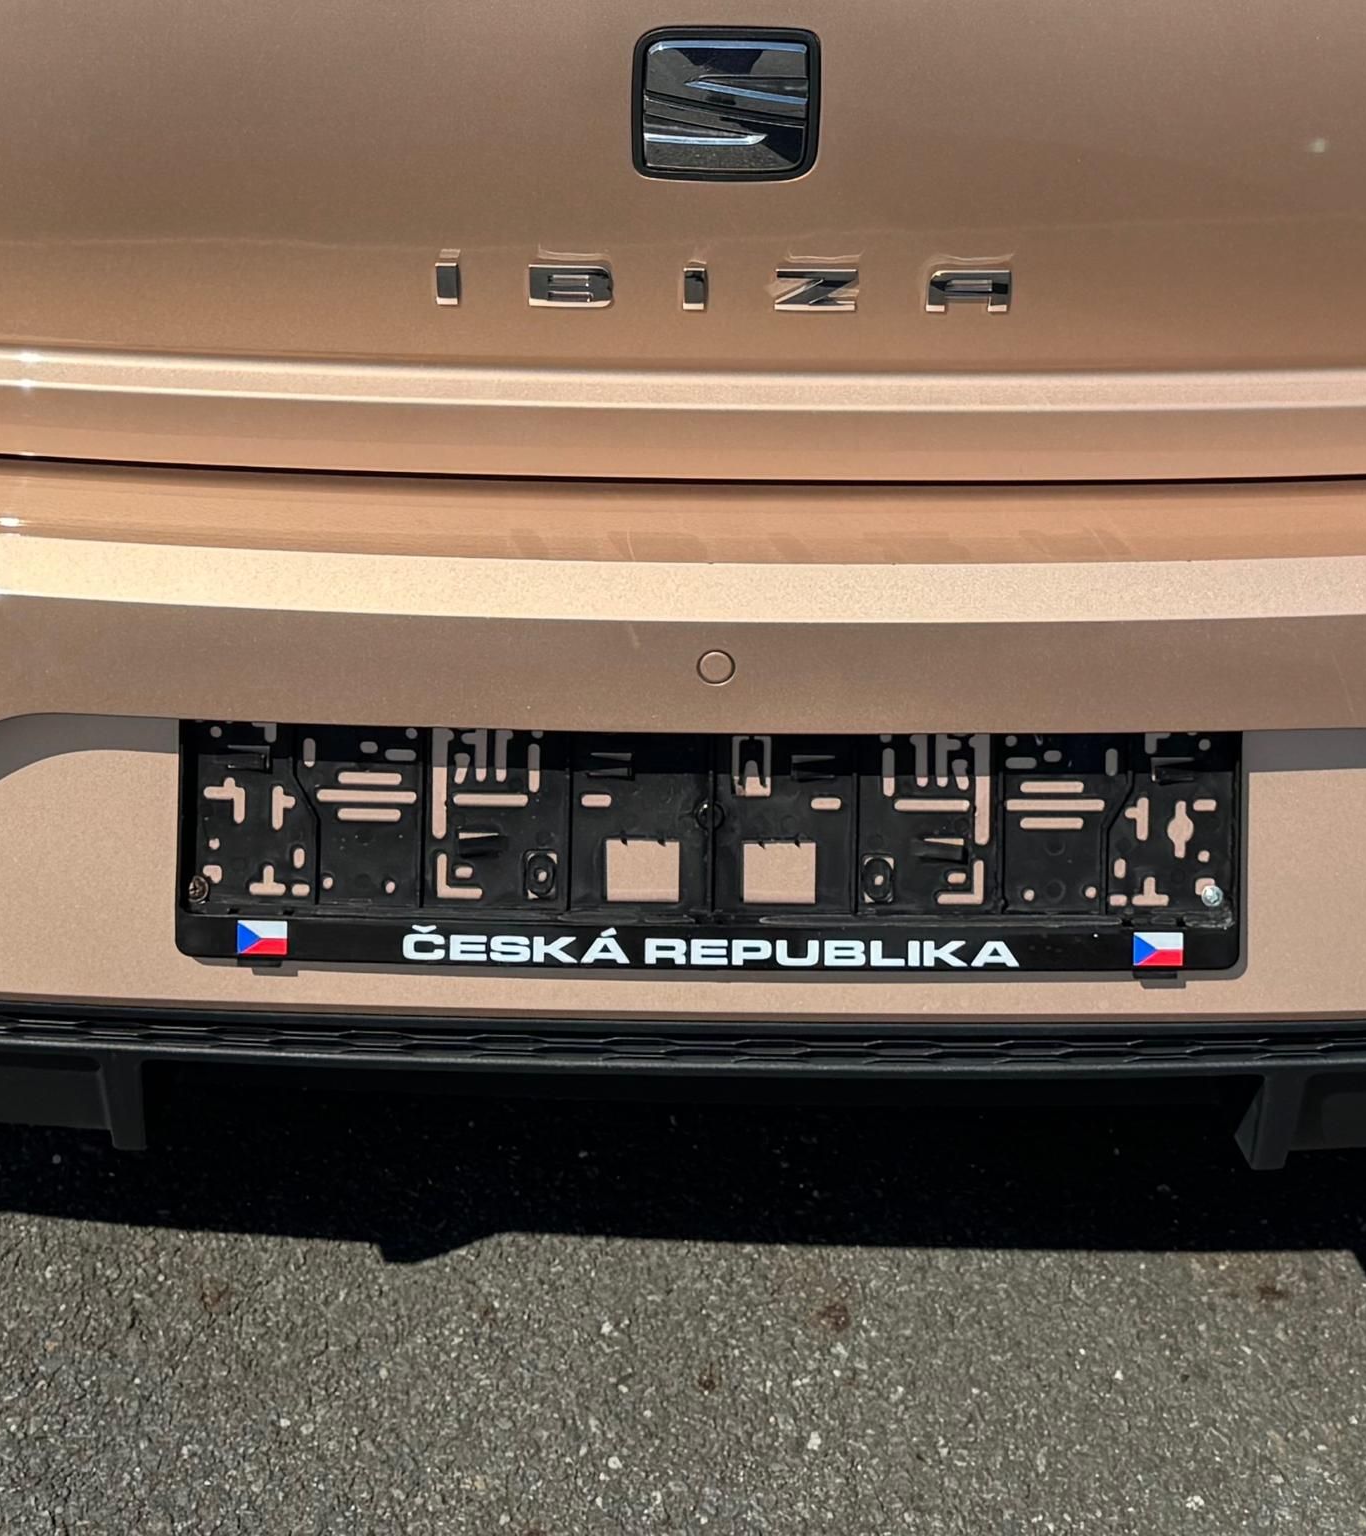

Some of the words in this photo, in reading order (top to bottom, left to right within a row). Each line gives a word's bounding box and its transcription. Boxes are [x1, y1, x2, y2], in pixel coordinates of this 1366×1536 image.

[435, 262, 1011, 313] IBIZA
[402, 925, 630, 964] ČESKÁ
[644, 938, 1019, 967] REPUBLIKA
